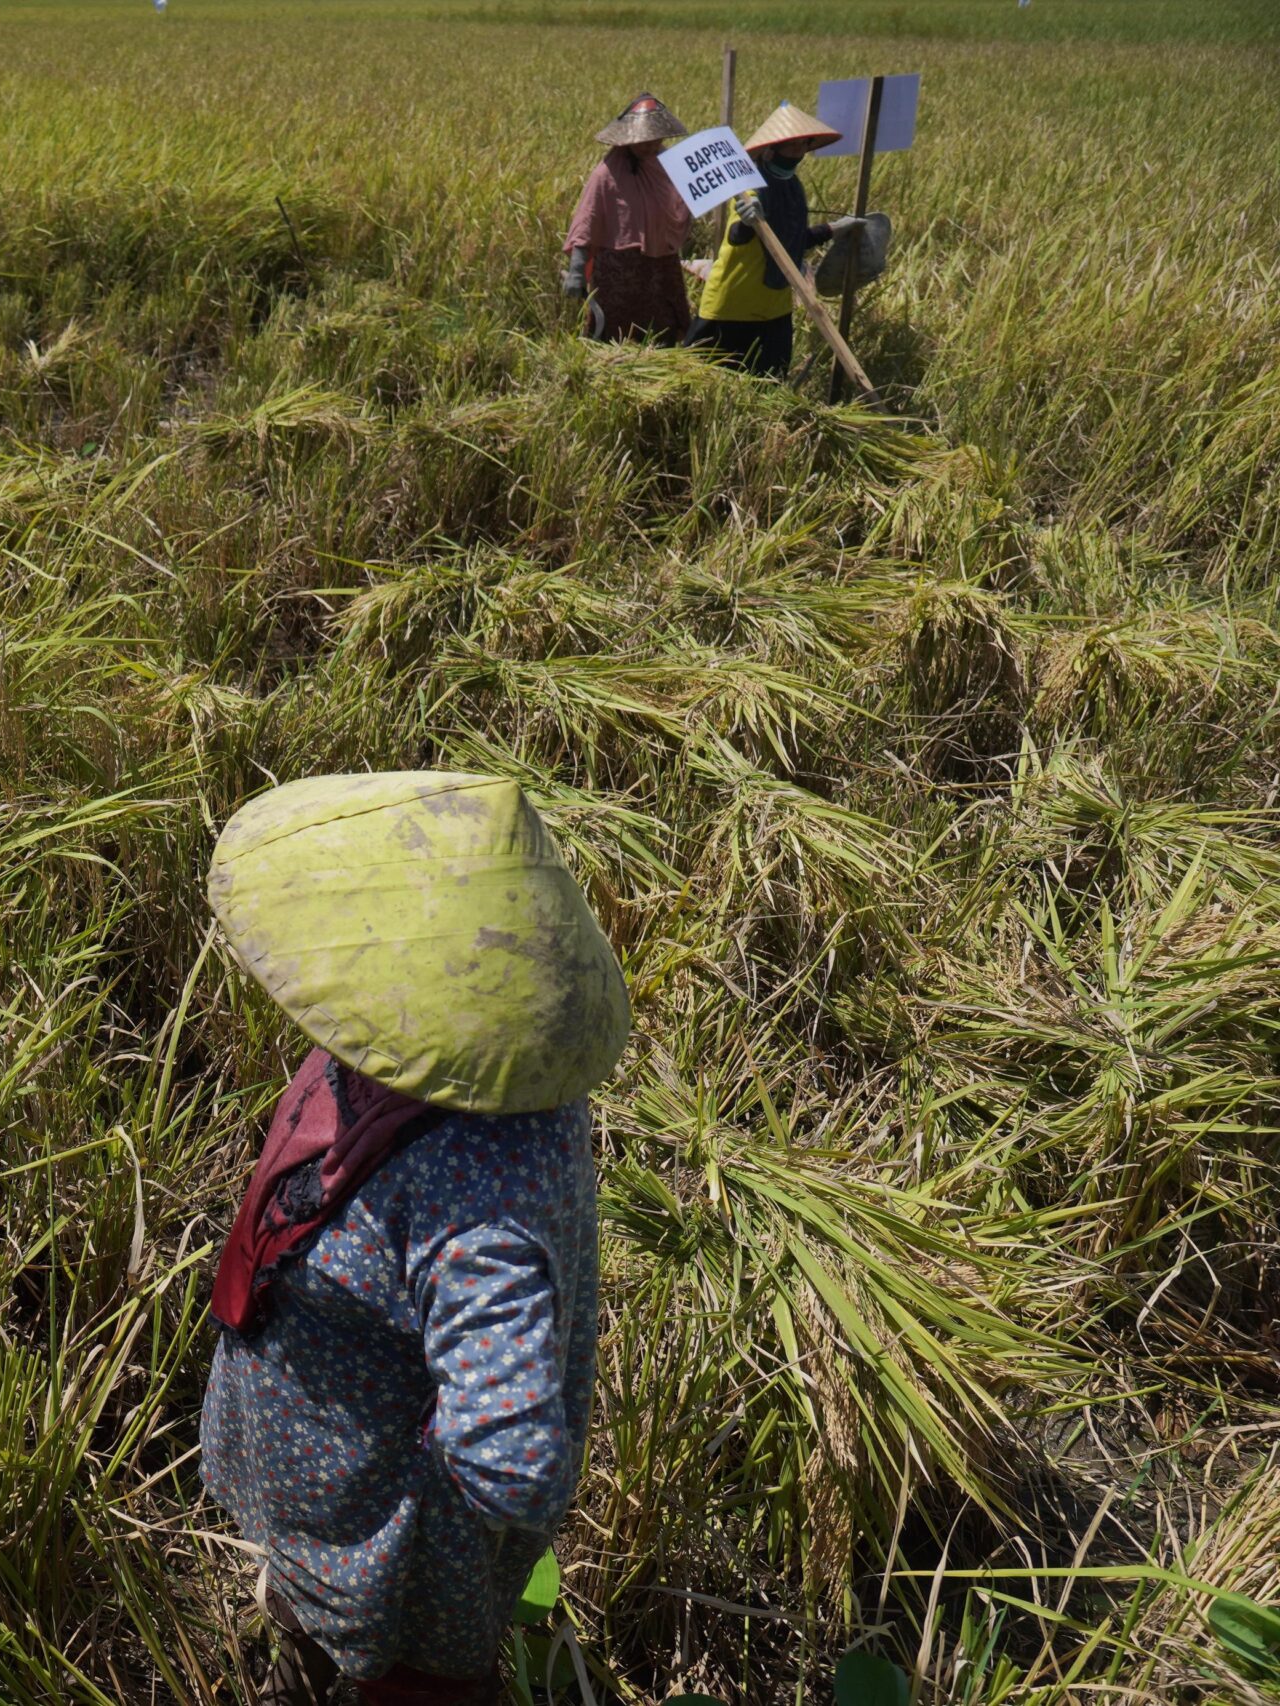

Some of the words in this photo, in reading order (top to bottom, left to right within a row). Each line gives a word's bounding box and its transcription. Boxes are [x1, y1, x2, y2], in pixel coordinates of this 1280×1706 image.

[684, 140, 737, 173] BAPPEDA
[687, 167, 727, 201] ACEH
[723, 159, 755, 180] UTARA
